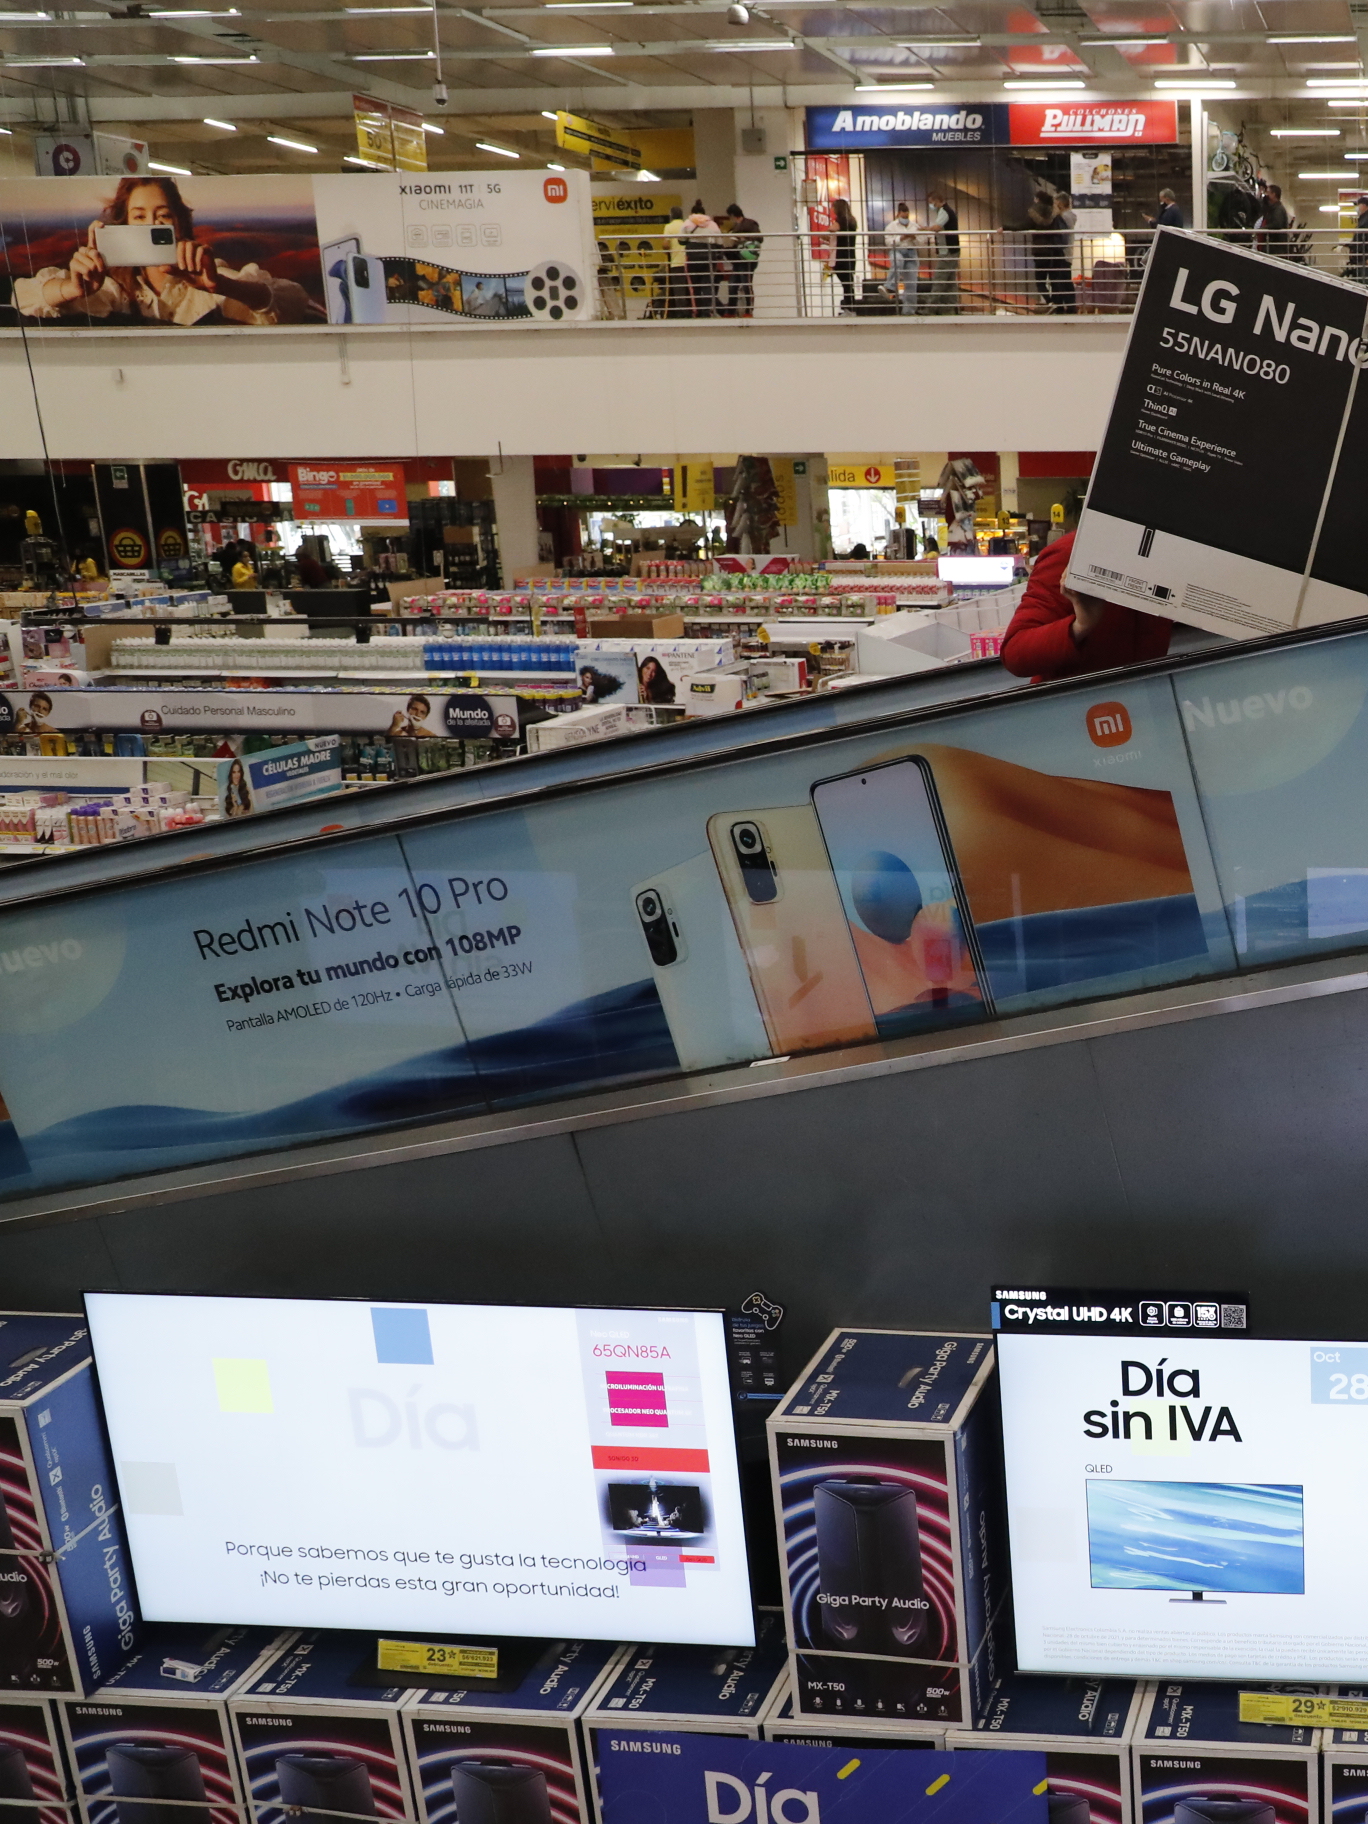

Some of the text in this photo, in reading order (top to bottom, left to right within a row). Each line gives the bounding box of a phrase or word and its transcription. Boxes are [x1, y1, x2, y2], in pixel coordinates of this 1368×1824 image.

[1069, 108, 1138, 116] COLCHONES
[831, 110, 983, 132] Amoblando
[931, 131, 981, 142] MUEBLES
[458, 184, 474, 194] 11T
[487, 184, 501, 194] 5G
[419, 199, 485, 210] CINEMAGIA
[1169, 267, 1240, 324] LG
[1159, 327, 1291, 385] 55NANO80
[1151, 362, 1246, 400] Pure Colors in Real 4K
[1144, 399, 1168, 414] ThinQ
[1138, 420, 1237, 458] True Cinema Experience
[1131, 440, 1212, 473] Ultimate Gameplay
[1053, 511, 1061, 519] 14
[667, 652, 695, 660] PANTENE
[692, 684, 711, 693] Advil
[161, 705, 296, 717] Cuidado Personal Masculino
[449, 706, 489, 719] Mundo
[1181, 685, 1313, 732] Nuevo
[314, 738, 337, 750] NUEVO
[262, 749, 331, 776] CÉLULAS MADRE
[193, 874, 509, 961] Redmi Note 10 Pro
[213, 922, 524, 1007] Explora tu mundo con 108MP
[225, 960, 533, 1034] Pantalla AMOLED de 120Hz Carga rápida de 33W
[995, 1290, 1047, 1301] SAMSUNG
[1004, 1304, 1133, 1324] Crystal UHD 4K
[592, 1344, 672, 1360] 65QN85A
[1313, 1351, 1341, 1364] Oct
[1120, 1358, 1202, 1399] Día
[347, 1384, 482, 1453] Día
[1083, 1400, 1243, 1443] sin IVA
[787, 1438, 838, 1449] SAMSUNG
[1085, 1463, 1113, 1474] QLED
[225, 1541, 293, 1561] Porque
[298, 1543, 389, 1563] sabemos
[393, 1550, 430, 1567] que
[434, 1549, 455, 1564] te
[460, 1551, 514, 1570] gusta
[518, 1552, 536, 1567] la
[260, 1570, 620, 1599] ¡No te pierdas esta gran oportunidad!
[816, 1594, 930, 1611] Giga Party Audio
[426, 1647, 446, 1663] 23
[807, 1681, 845, 1692] MX-T50
[1292, 1699, 1315, 1714] 29
[610, 1739, 682, 1756] SAMSUNG
[704, 1772, 820, 1824] Día
